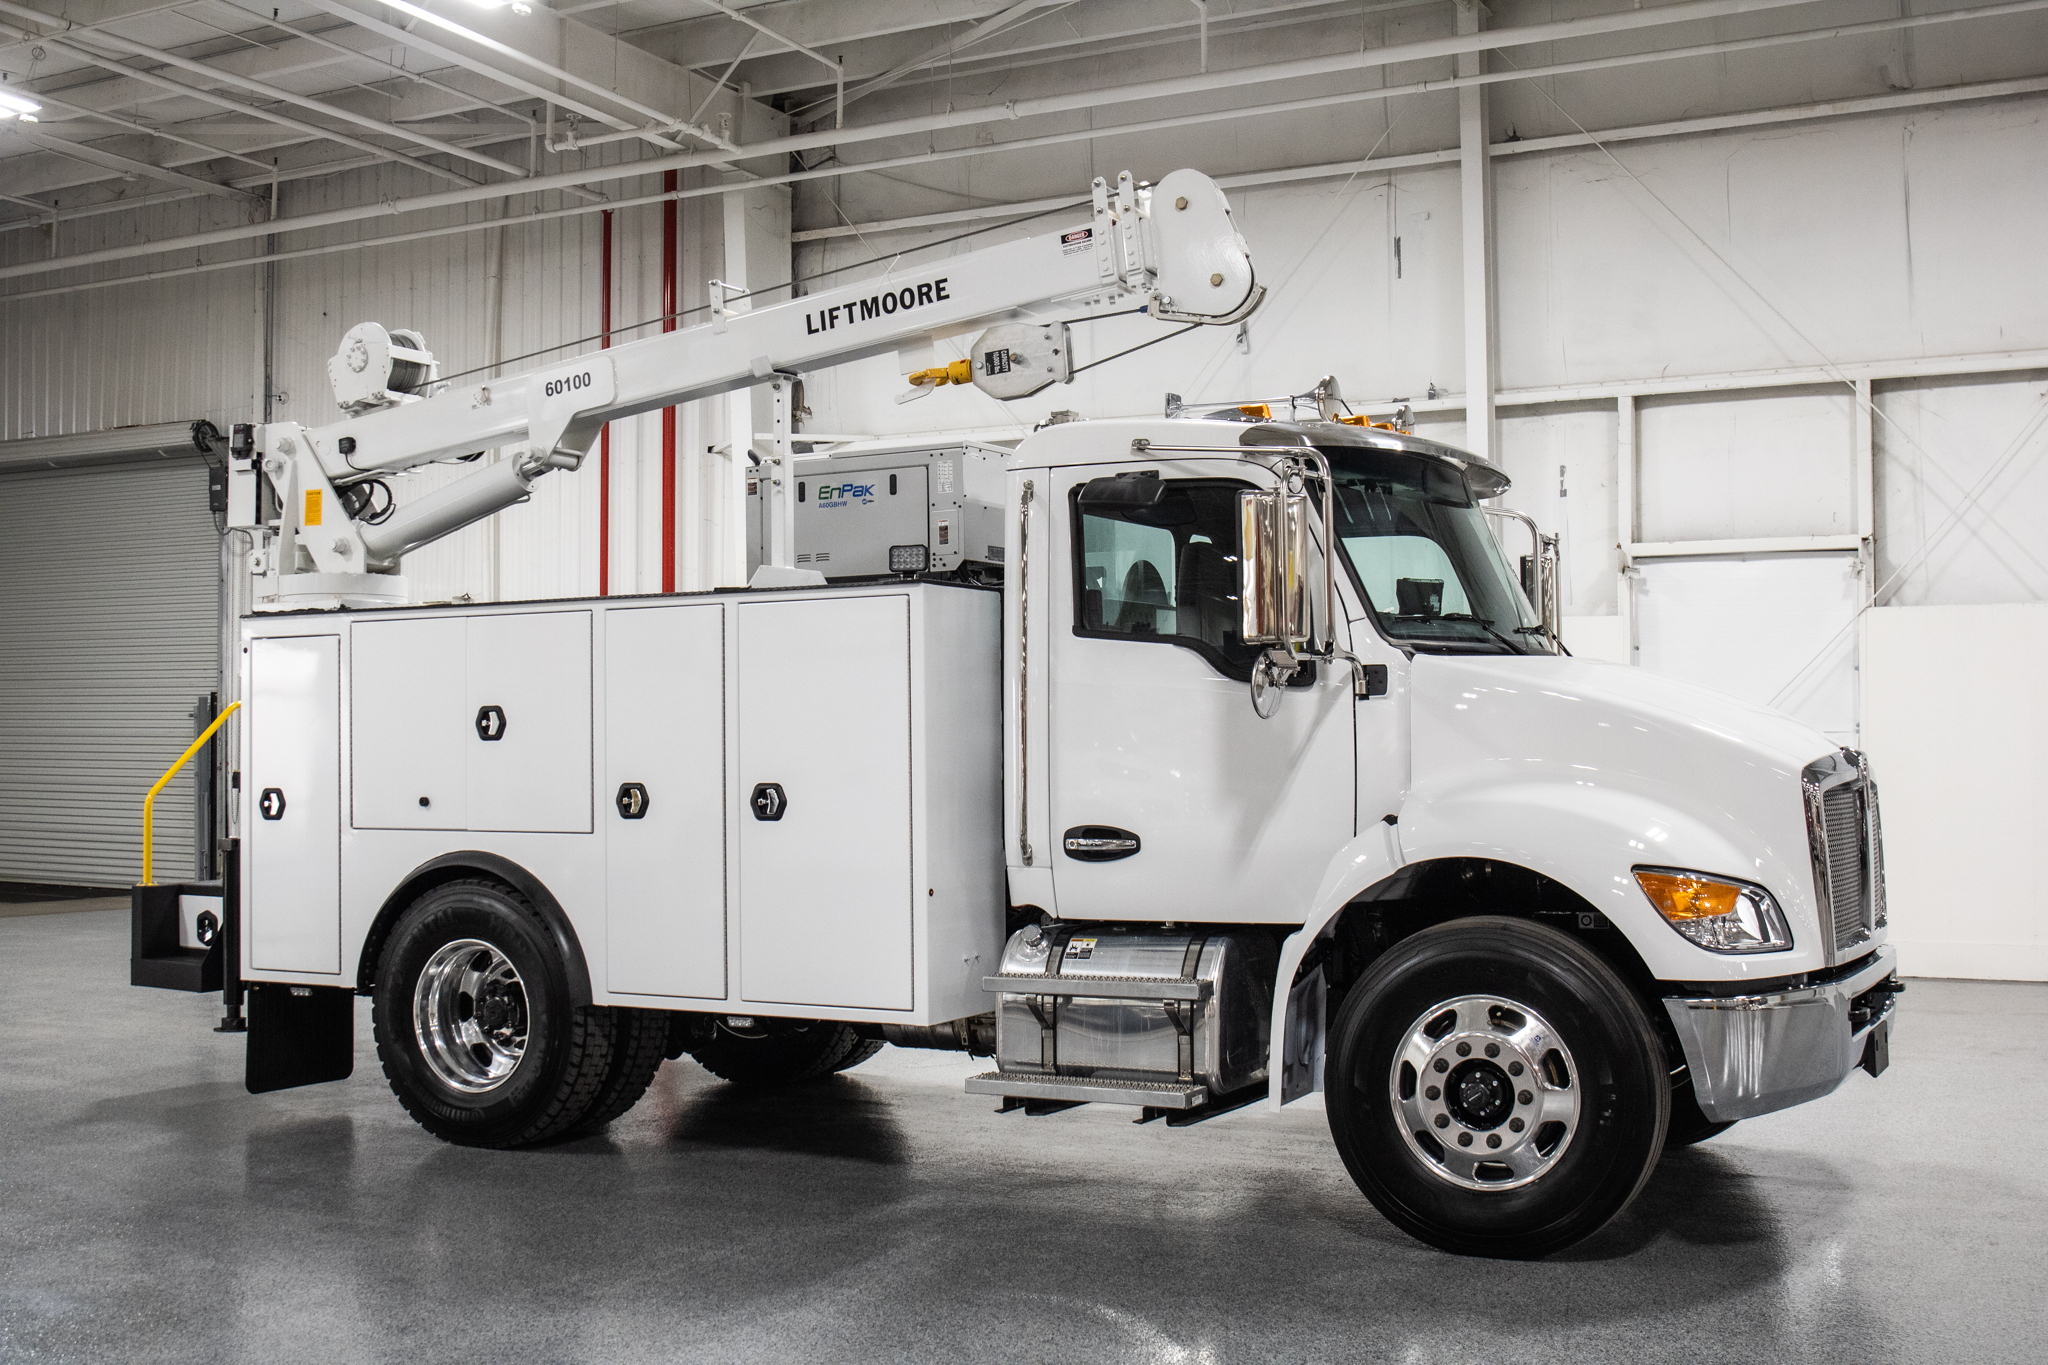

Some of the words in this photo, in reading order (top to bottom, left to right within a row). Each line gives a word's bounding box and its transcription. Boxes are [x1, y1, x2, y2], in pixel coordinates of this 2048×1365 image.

[806, 277, 950, 335] LIFTMOORE
[1000, 350, 1009, 372] CAPACITY
[545, 371, 591, 397] 60100
[818, 483, 875, 500] EnPak
